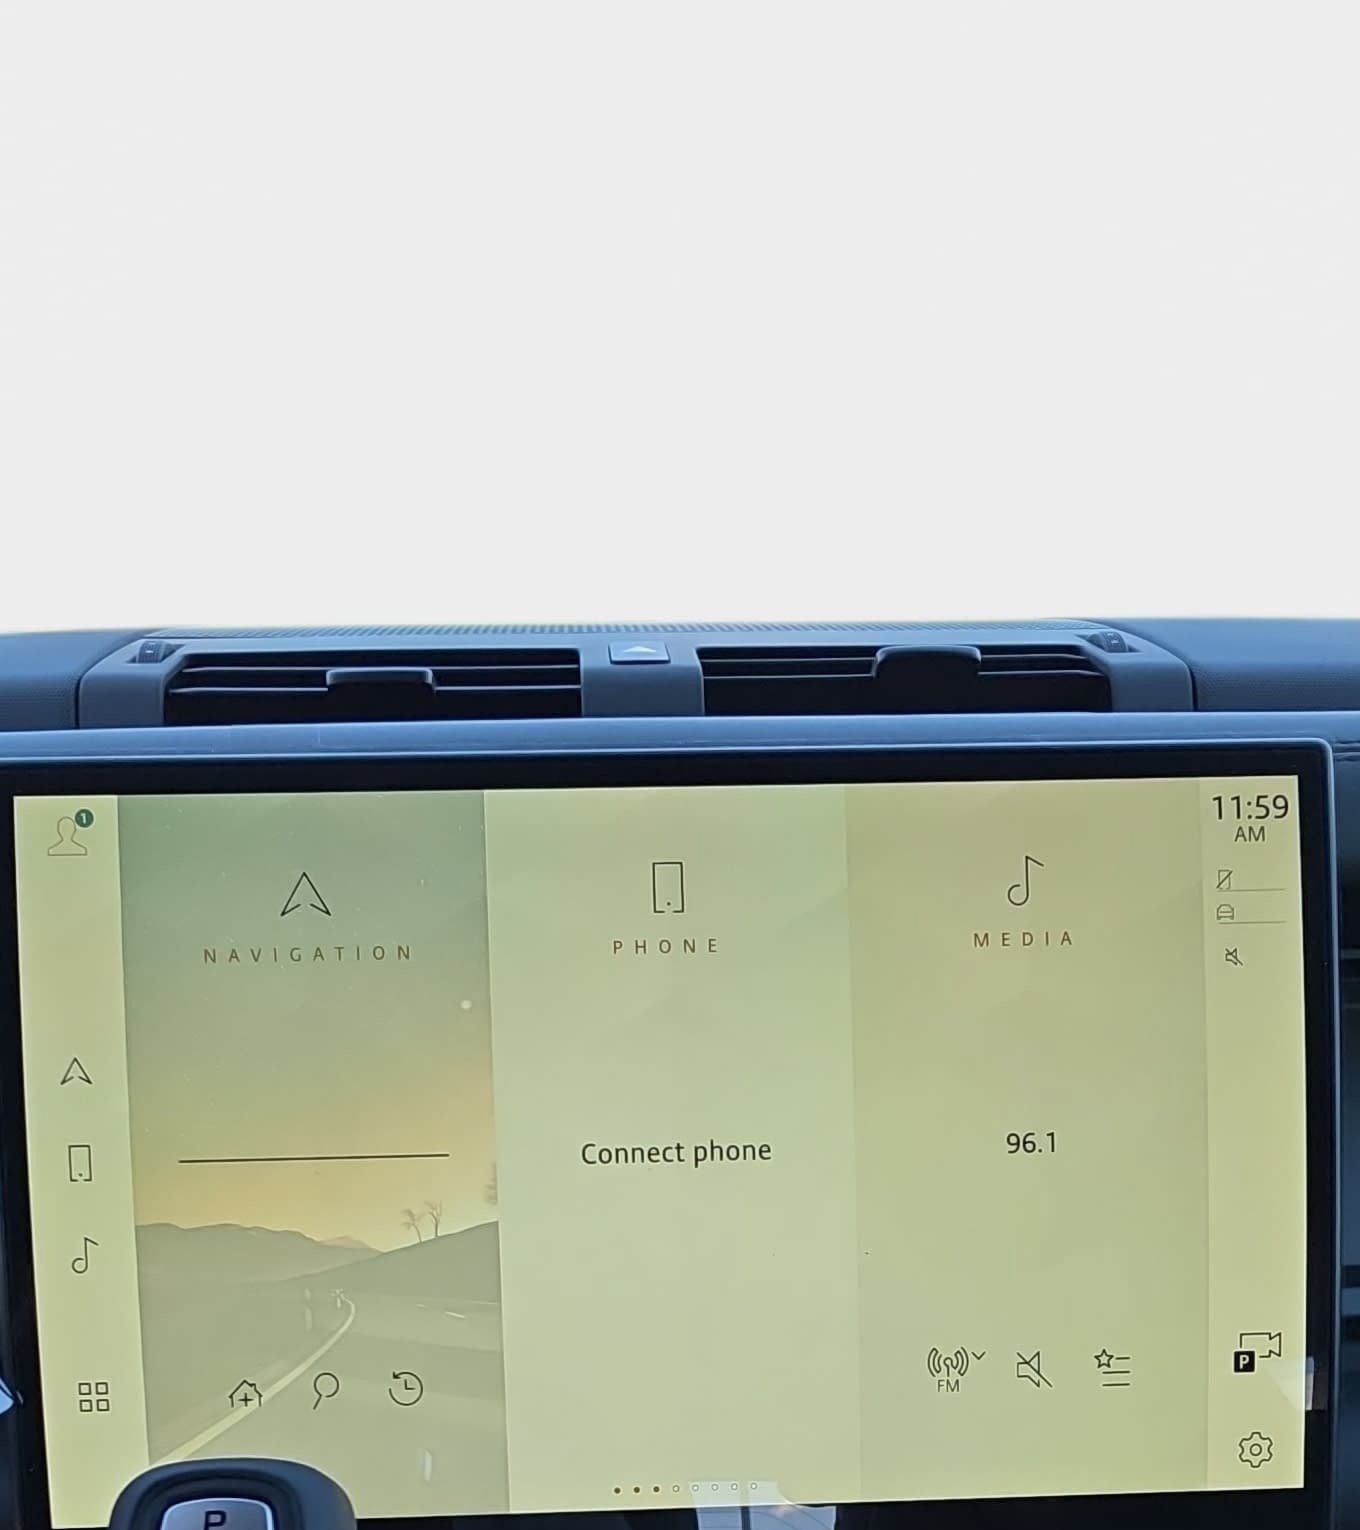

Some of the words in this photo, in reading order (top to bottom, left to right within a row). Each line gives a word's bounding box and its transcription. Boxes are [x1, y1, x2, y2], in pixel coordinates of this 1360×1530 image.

[1211, 794, 1289, 821] 11:59
[1234, 825, 1267, 843] AM
[612, 936, 720, 956] PHONE
[973, 929, 1075, 948] MEDIA
[202, 944, 413, 965] NAVIGATION
[581, 1141, 685, 1166] Connect
[693, 1138, 772, 1167] phone
[1005, 1131, 1058, 1155] 96.1
[936, 1378, 960, 1393] FM
